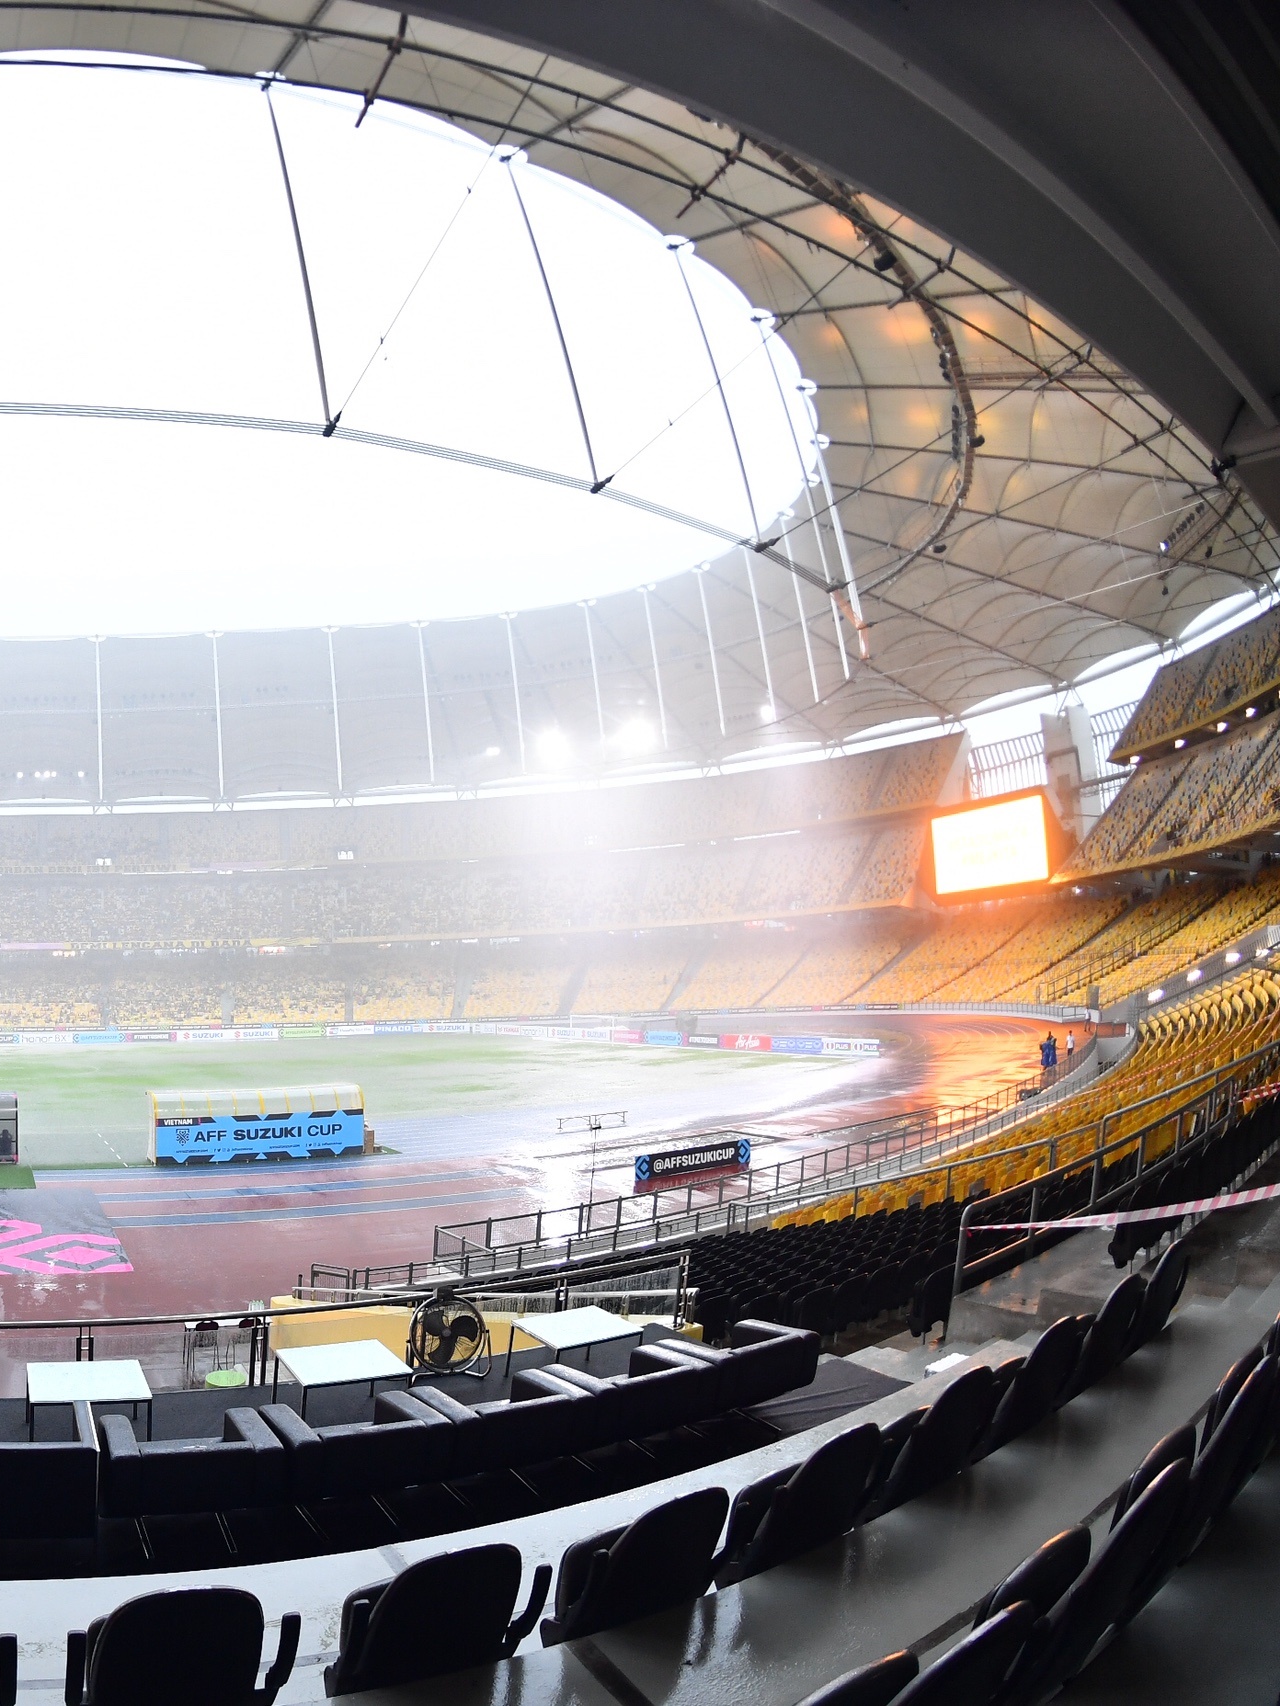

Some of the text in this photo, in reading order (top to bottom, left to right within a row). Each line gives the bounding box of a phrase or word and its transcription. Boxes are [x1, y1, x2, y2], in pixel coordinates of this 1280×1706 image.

[21, 1035, 53, 1043] honor
[586, 1030, 607, 1039] SUZUKI
[163, 1118, 193, 1126] VIETNAM
[193, 1124, 343, 1143] AFF SUZUKI CUP
[653, 1147, 735, 1173] @AFFSUZUKICUP
